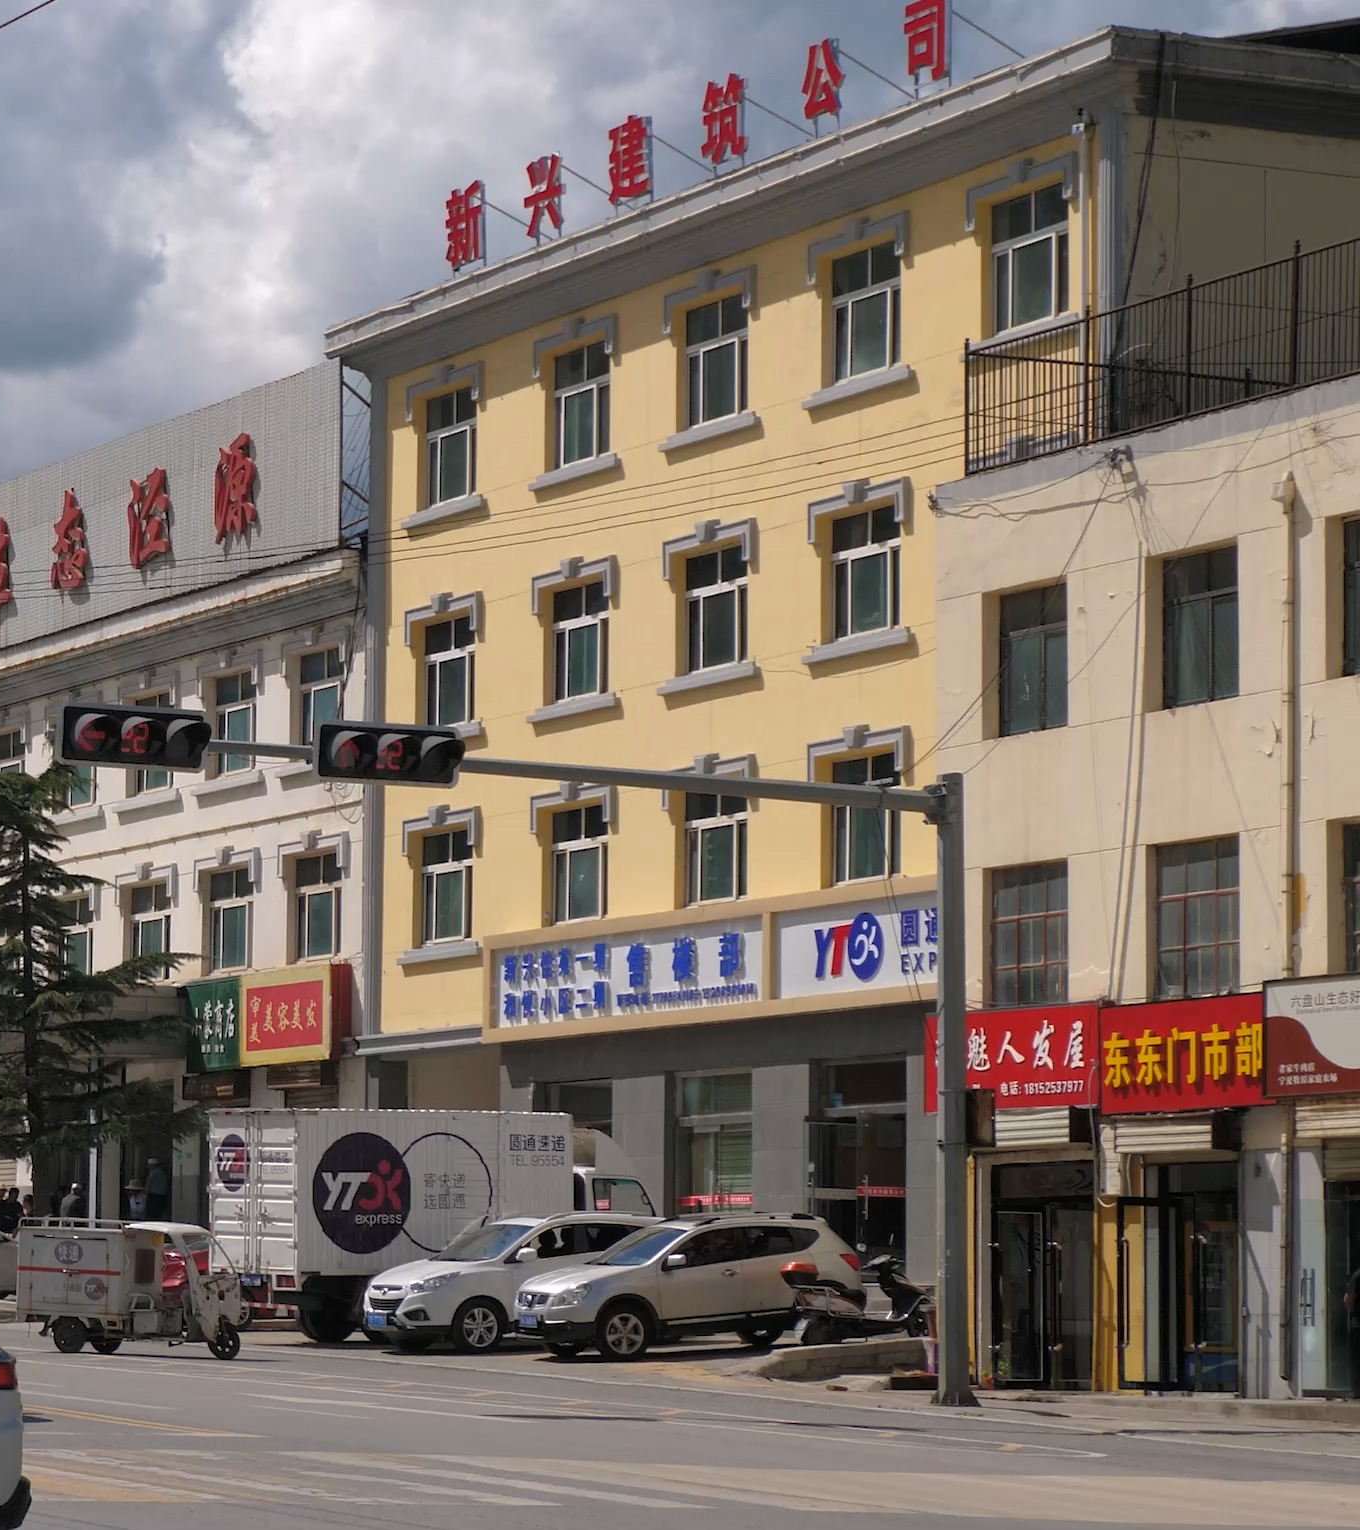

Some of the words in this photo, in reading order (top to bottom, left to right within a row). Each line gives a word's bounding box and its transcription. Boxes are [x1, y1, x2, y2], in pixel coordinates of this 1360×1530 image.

[445, 0, 947, 269] 新兴建筑公司
[627, 932, 741, 987] 售楼部
[1290, 990, 1360, 1008] 六盘山生态好
[263, 998, 317, 1034] 美容美发
[936, 1019, 1086, 1071] 魅人发屋
[1103, 1021, 1263, 1088] 东东门市部
[1024, 1080, 1085, 1095] 18152537977
[509, 1134, 566, 1152] 圆通速递
[510, 1154, 528, 1166] TEL
[531, 1154, 565, 1166] 95554
[423, 1173, 466, 1190] 寄快递
[355, 1212, 403, 1226] express
